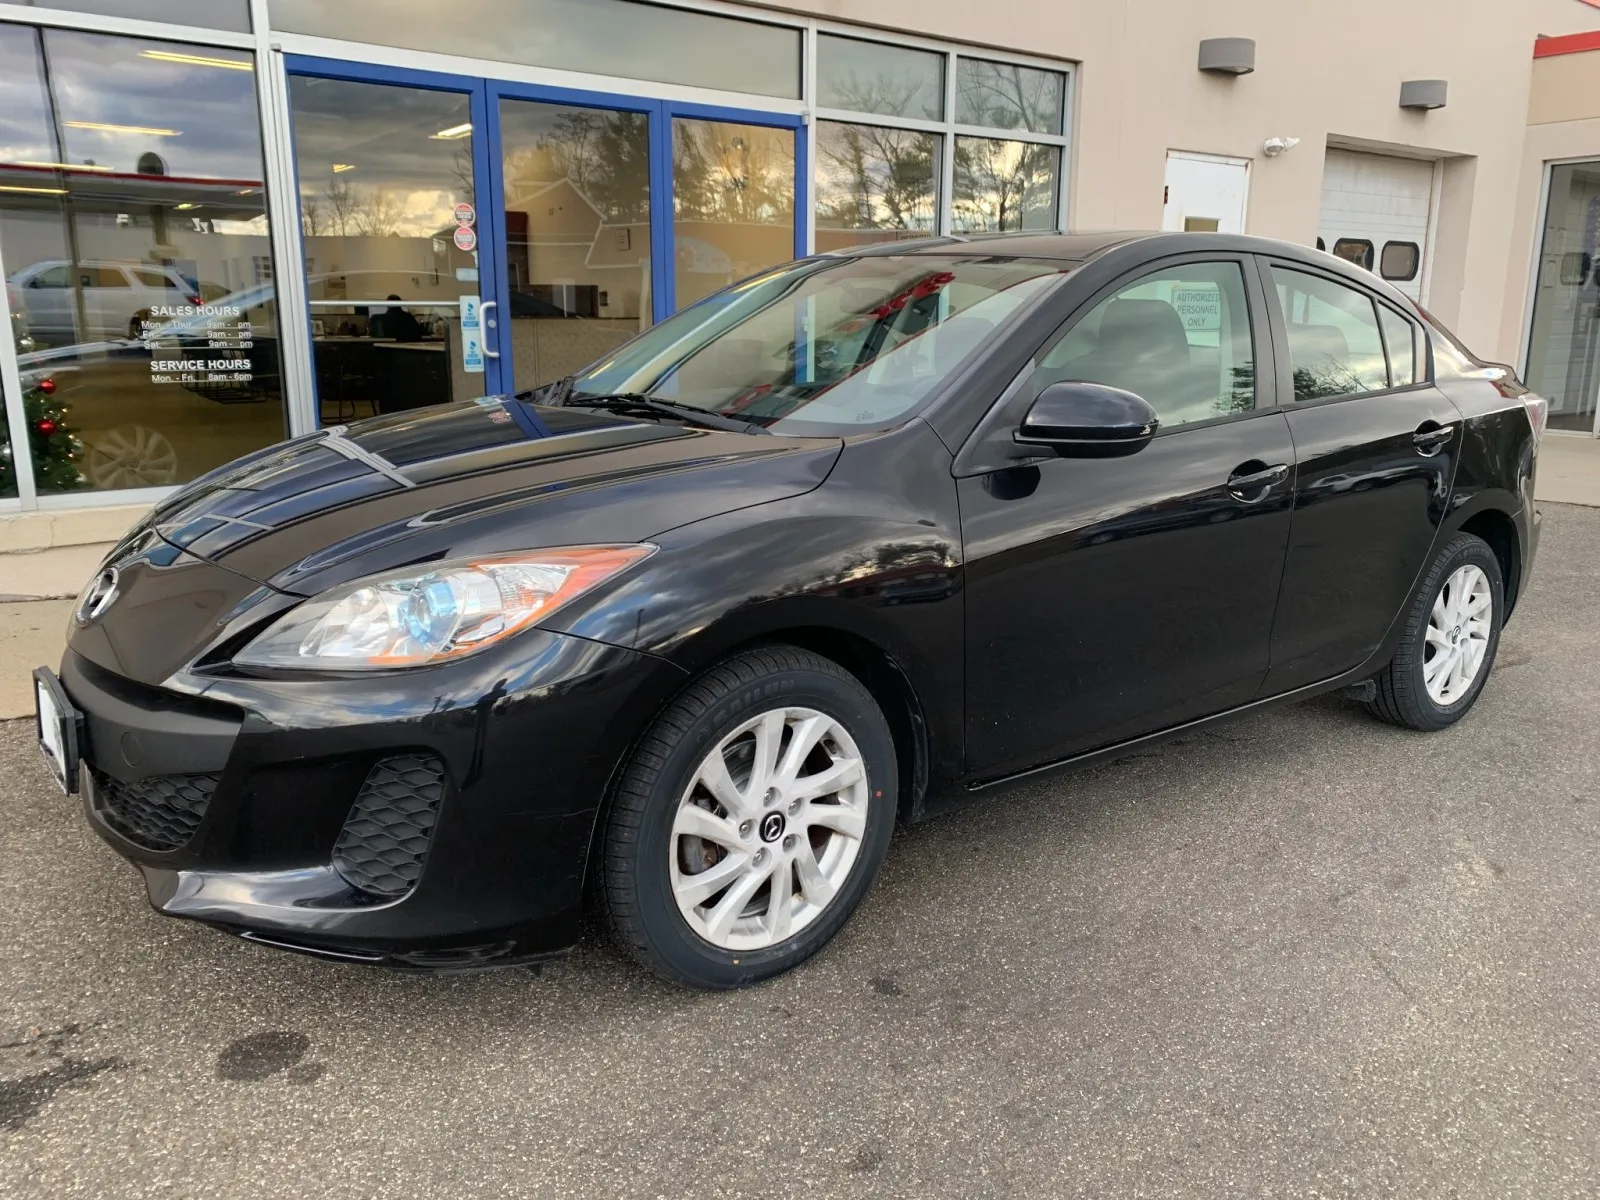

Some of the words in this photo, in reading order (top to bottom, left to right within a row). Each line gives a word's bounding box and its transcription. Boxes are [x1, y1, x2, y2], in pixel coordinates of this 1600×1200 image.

[1177, 293, 1220, 302] AUTHORIZED
[151, 305, 192, 316] SALES
[196, 305, 240, 316] HOURS
[1177, 305, 1218, 315] PERSONNEL
[206, 321, 225, 329] 9am
[1188, 318, 1206, 327] ONLY
[207, 330, 226, 338] 9am
[208, 340, 227, 348] 9am
[150, 360, 204, 370] SERVICE
[208, 359, 251, 369] HOURS
[151, 374, 174, 383] Mon.
[181, 373, 196, 382] Fri.
[208, 373, 226, 381] 8am
